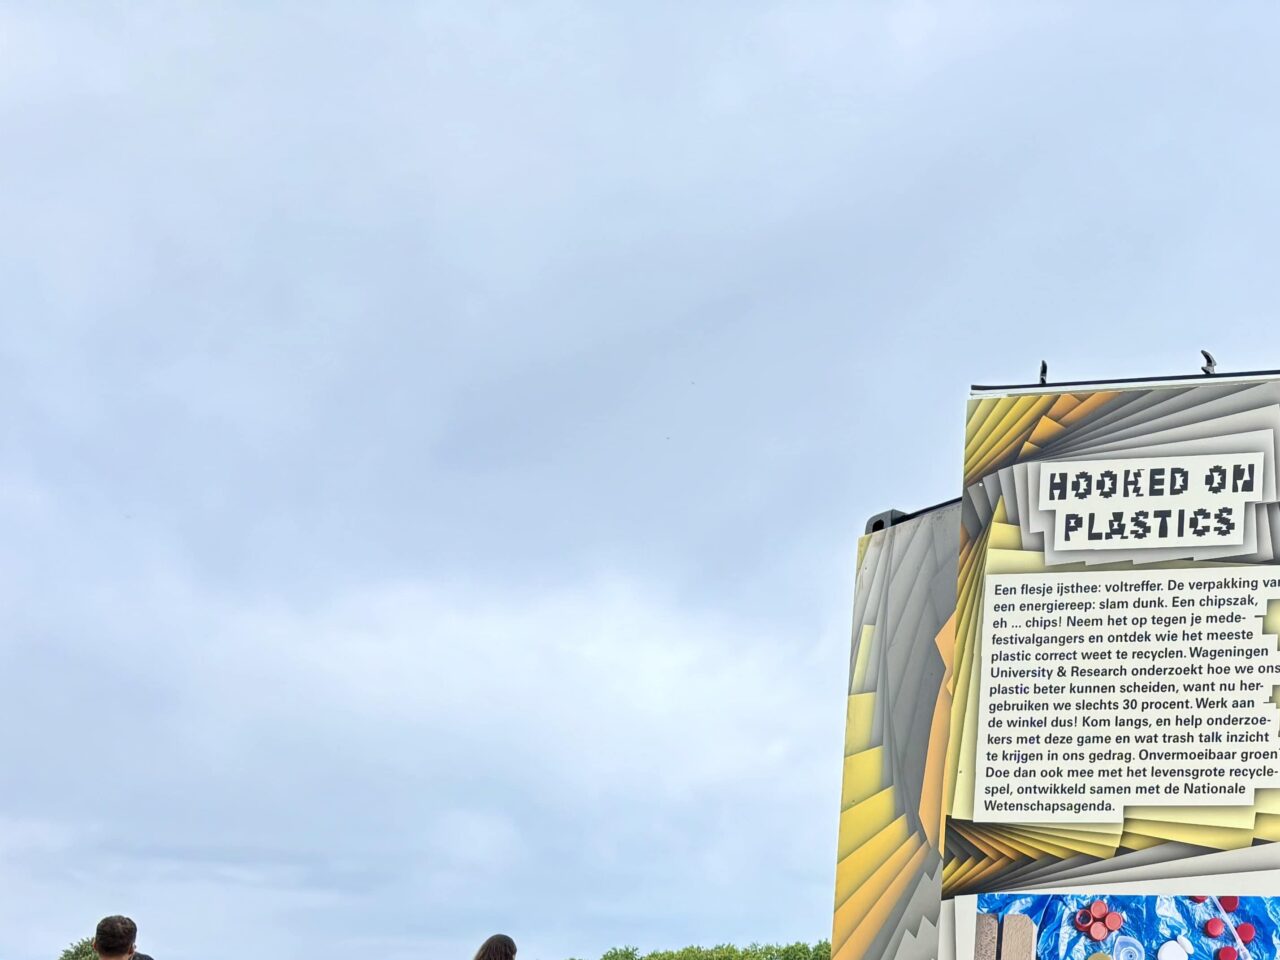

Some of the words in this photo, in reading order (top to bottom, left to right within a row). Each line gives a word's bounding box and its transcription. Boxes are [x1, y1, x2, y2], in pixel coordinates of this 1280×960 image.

[1049, 468, 1189, 501] HOOKED
[1204, 463, 1255, 494] ON
[1064, 506, 1236, 542] PLASTICS
[994, 583, 1017, 596] Een
[1020, 582, 1053, 597] flesje
[1056, 581, 1101, 597] ijsthee:
[1104, 579, 1164, 593] voltreffer.
[1167, 578, 1185, 591] De
[1187, 576, 1259, 593] verpakking
[992, 602, 1015, 612] een
[1018, 598, 1095, 614] energiereep:
[1098, 597, 1129, 610] slam
[1132, 596, 1168, 609] dunk.
[1171, 595, 1195, 608] Een
[1198, 593, 1258, 609] chipszak,
[992, 616, 1007, 629] eh
[1024, 615, 1062, 630] chips!
[1066, 615, 1103, 627] Neem
[1106, 614, 1128, 626] het
[1131, 616, 1148, 628] op
[1150, 614, 1187, 628] tegen
[1189, 612, 1202, 627] je
[1205, 611, 1246, 624] mede-
[991, 632, 1085, 647] festivalgangers
[1087, 634, 1103, 644] en
[1106, 630, 1151, 643] ontdek
[1154, 629, 1178, 642] wie
[1181, 629, 1203, 642] het
[1206, 629, 1254, 641] meeste
[990, 649, 1031, 665] plastic
[1034, 649, 1078, 661] correct
[1080, 649, 1112, 660] weet
[1115, 648, 1128, 660] te
[1131, 646, 1187, 662] recyclen.
[1188, 645, 1269, 661] Wageningen
[990, 665, 1054, 680] University
[1056, 665, 1067, 678] &
[1070, 664, 1127, 677] Research
[1130, 663, 1203, 676] onderzoekt
[1206, 662, 1231, 675] hoe
[1233, 664, 1254, 674] we
[988, 682, 1030, 698] plastic
[1032, 682, 1066, 695] beter
[1068, 682, 1116, 694] kunnen
[1119, 680, 1179, 694] scheiden,
[1182, 680, 1216, 692] want
[1218, 682, 1236, 692] nu
[1239, 679, 1264, 691] her-
[988, 699, 1049, 714] gebruiken
[1052, 701, 1072, 711] we
[1074, 698, 1119, 711] slechts
[1122, 698, 1138, 710] 30
[1140, 698, 1193, 713] procent.
[1194, 696, 1228, 709] Werk
[1231, 699, 1255, 709] aan
[987, 716, 1003, 728] de
[1006, 715, 1047, 728] winkel
[1050, 715, 1077, 728] dus!
[1081, 715, 1111, 727] Kom
[1114, 715, 1152, 730] langs,
[1155, 717, 1171, 727] en
[1174, 714, 1203, 729] help
[1206, 713, 1271, 726] onderzoe-
[986, 732, 1013, 745] kers
[1015, 733, 1041, 745] met
[1043, 732, 1073, 745] deze
[1076, 734, 1112, 747] game
[1114, 734, 1131, 744] en
[1133, 732, 1159, 744] wat
[1161, 731, 1194, 744] trash
[1197, 730, 1223, 743] talk
[1225, 730, 1270, 743] inzicht
[985, 750, 998, 762] te
[1001, 749, 1043, 764] krijgen
[1046, 749, 1058, 761] in
[1061, 752, 1085, 761] ons
[1088, 748, 1135, 764] gedrag.
[1138, 747, 1237, 761] Onvermoeibaar
[985, 766, 1010, 778] Doe
[1012, 766, 1036, 778] dan
[1039, 765, 1063, 778] ook
[1066, 768, 1094, 778] mee
[1097, 767, 1123, 778] met
[1126, 765, 1147, 778] het
[1150, 765, 1225, 780] levensgrote
[1228, 764, 1278, 780] recycle-
[984, 782, 1013, 797] spel,
[1016, 782, 1086, 795] ontwikkeld
[1089, 785, 1131, 795] samen
[1134, 783, 1160, 795] met
[1163, 782, 1180, 795] de
[1183, 782, 1246, 794] Nationale
[983, 799, 1115, 814] Wetenschapsagenda.
